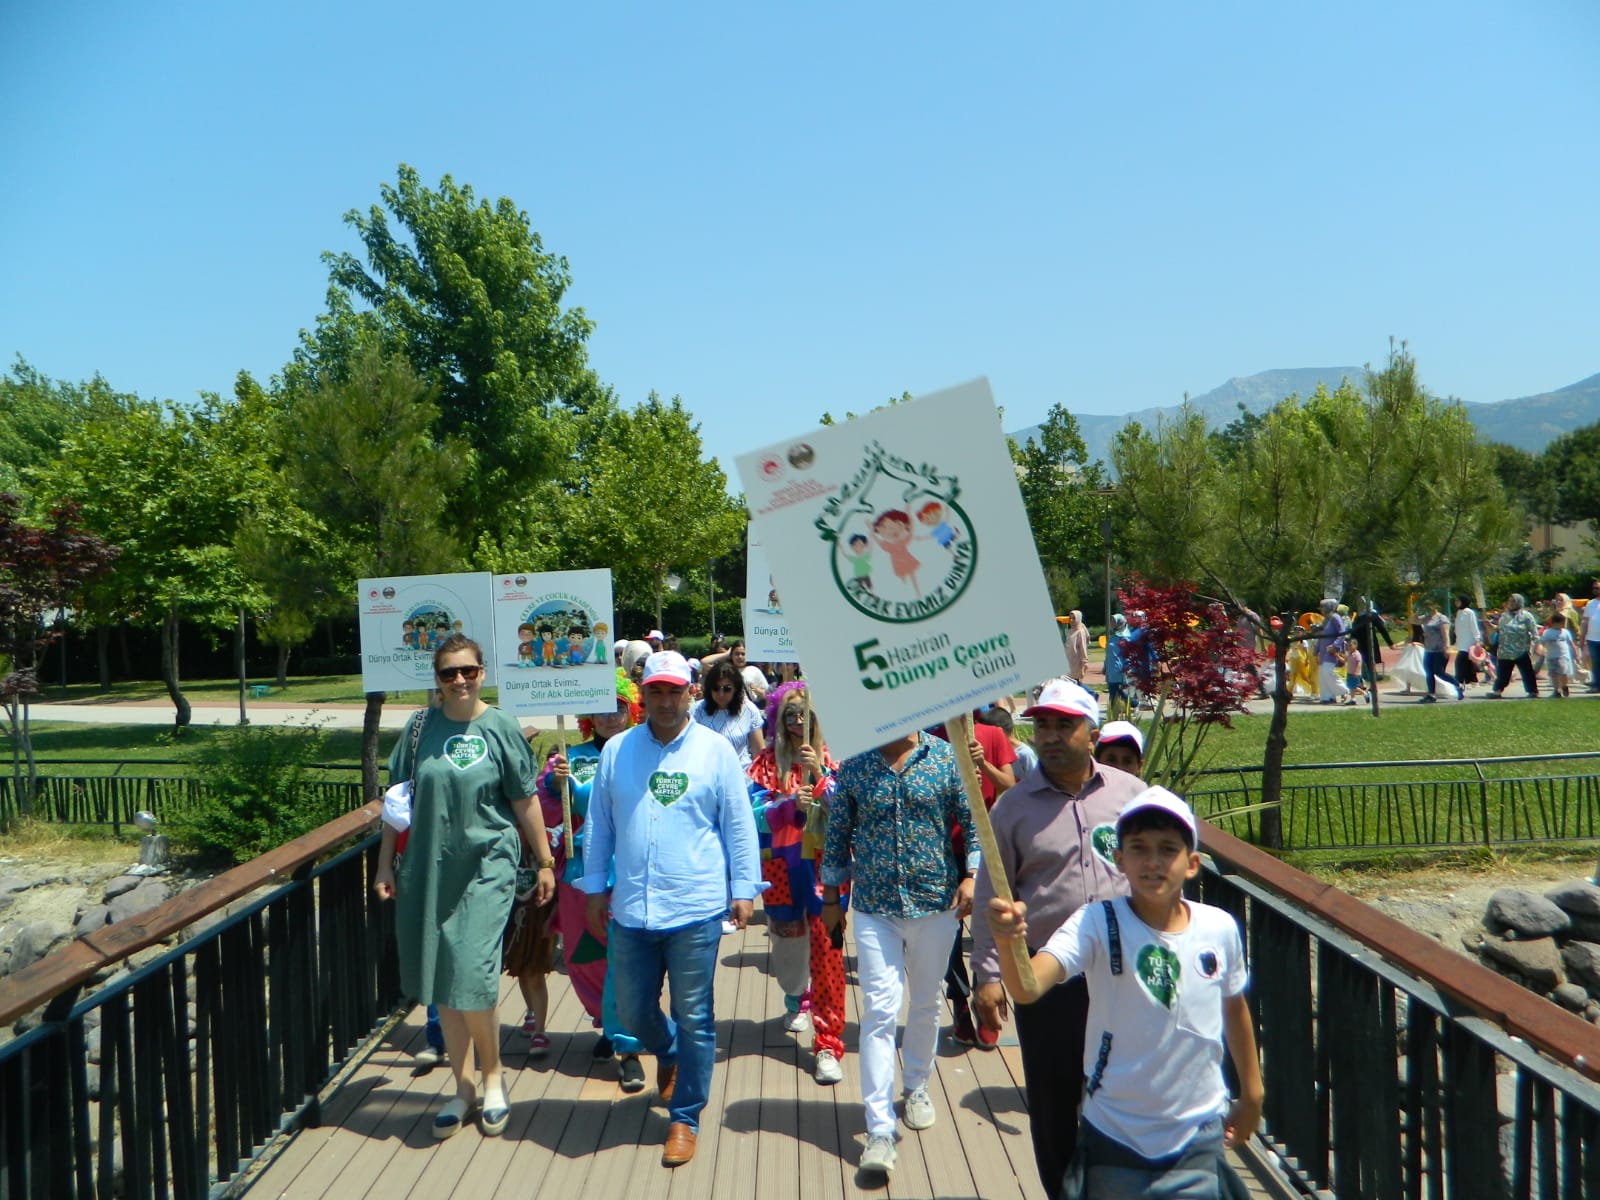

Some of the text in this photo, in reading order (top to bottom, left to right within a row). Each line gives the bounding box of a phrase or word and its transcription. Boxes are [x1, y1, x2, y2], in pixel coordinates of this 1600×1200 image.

[753, 626, 778, 637] Dünya
[368, 654, 391, 664] Dünya
[393, 653, 412, 663] Ortak
[853, 632, 951, 690] 5 Haziran
[884, 632, 1010, 690] Dünya Çevre
[971, 649, 1017, 680] Günü
[505, 681, 530, 690] Dünya
[532, 679, 552, 689] Ortak
[531, 690, 546, 699] Sıfır
[564, 688, 610, 697] Geleceğimiz
